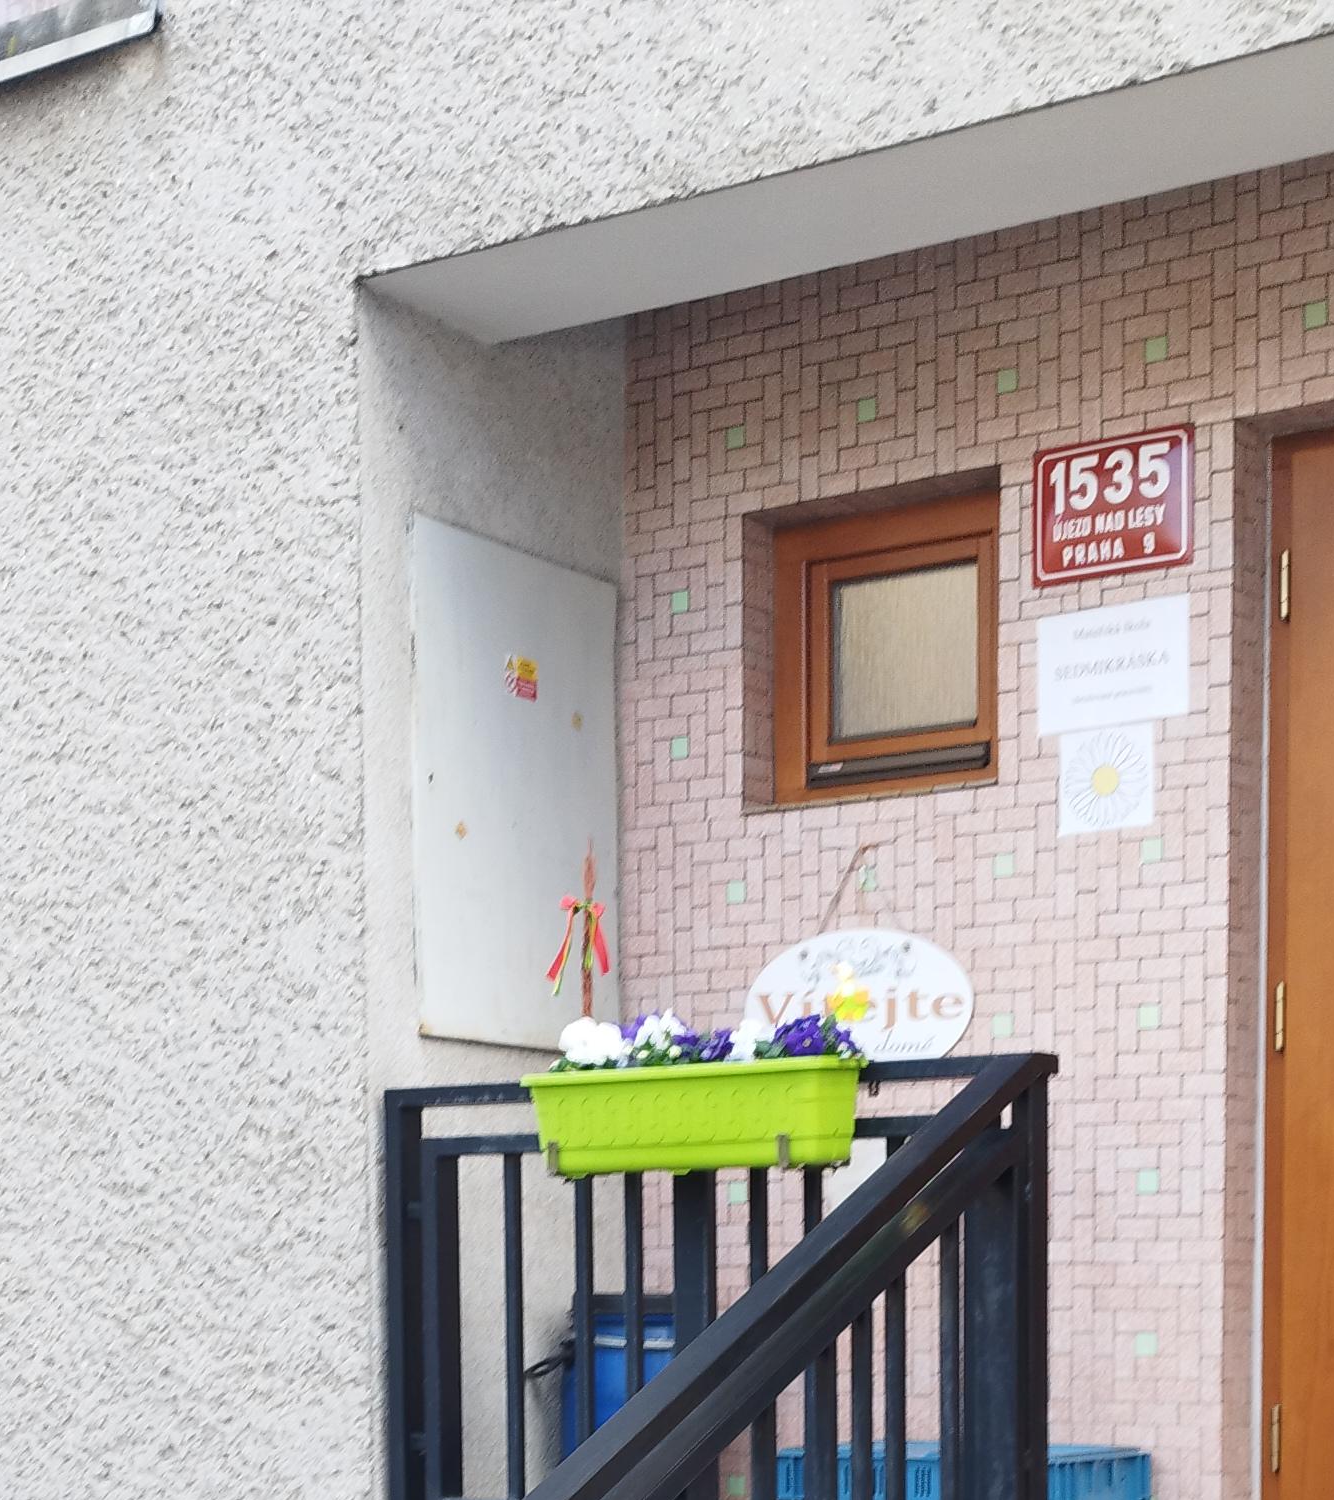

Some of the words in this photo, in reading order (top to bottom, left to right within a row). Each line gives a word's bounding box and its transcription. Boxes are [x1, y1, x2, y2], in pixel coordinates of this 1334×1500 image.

[1050, 441, 1170, 515] 1535
[1095, 510, 1125, 534] NAD
[1128, 504, 1166, 529] LESY
[1062, 537, 1124, 568] PRAHA
[1143, 532, 1155, 554] 9
